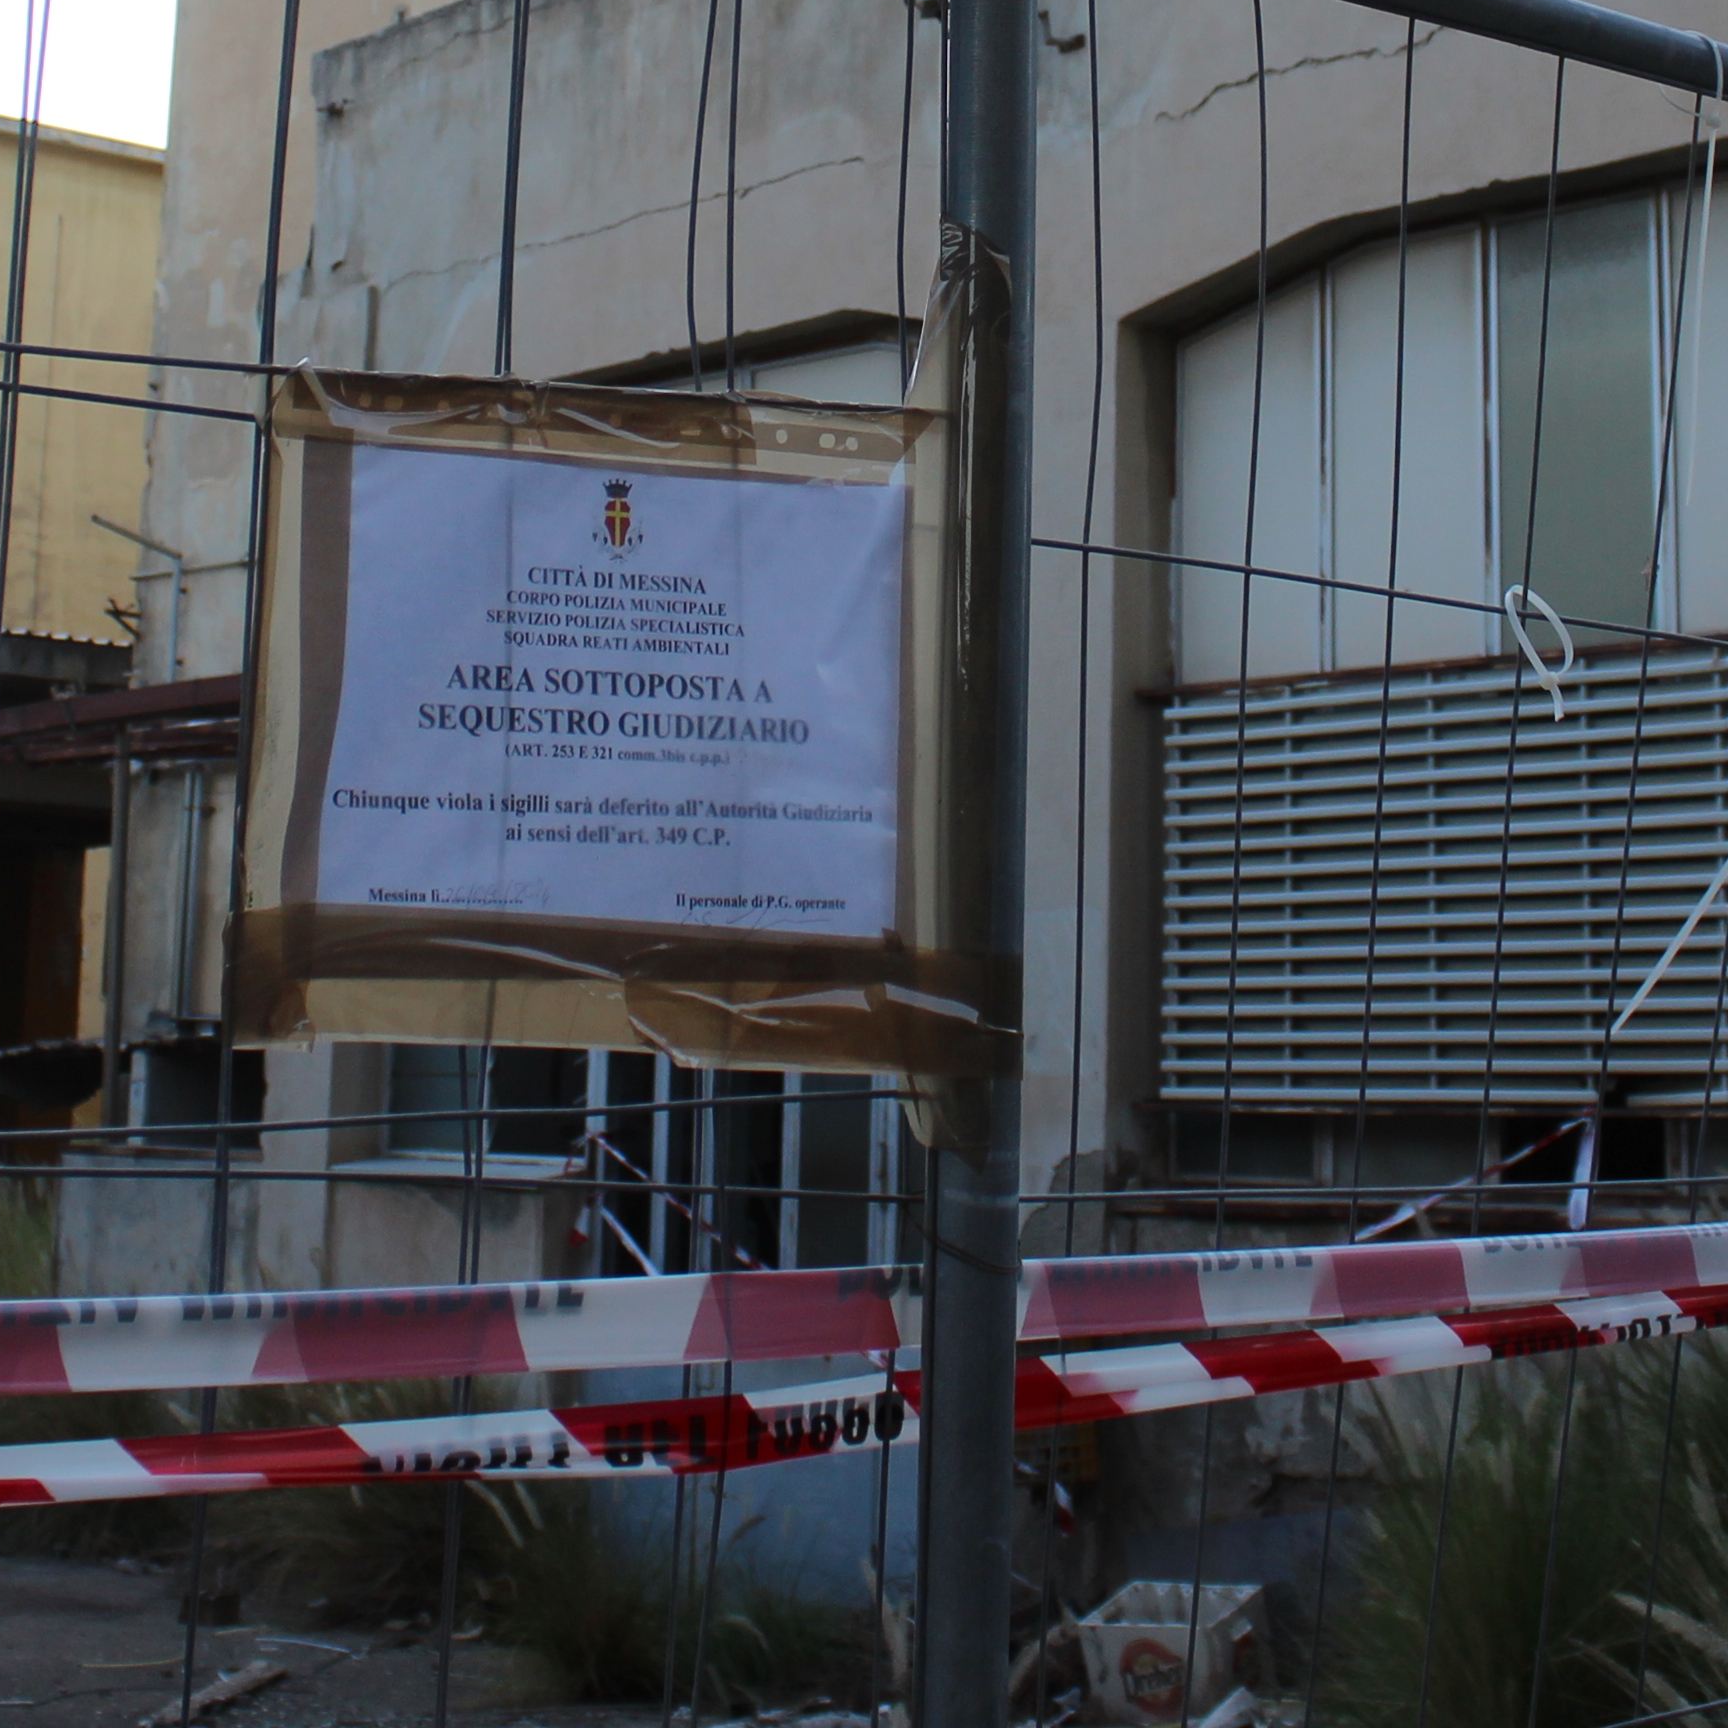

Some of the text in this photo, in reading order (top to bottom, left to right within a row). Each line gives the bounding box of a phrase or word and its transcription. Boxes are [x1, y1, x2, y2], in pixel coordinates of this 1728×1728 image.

[527, 565, 706, 595] CITTÀ DI MESSINA
[506, 590, 727, 617] CORPO POLIZIA MUNICIPALE
[486, 609, 745, 637] SERVIZIO POLIZIA SPECIALISTICA
[503, 630, 730, 656] SQUADRA REATI AMBIENTALI
[446, 664, 774, 703] AREA SOTTOPOSTA A
[417, 703, 811, 745] SEQUESTRO GIUDIZIARIO
[505, 743, 547, 758] (ART.
[552, 745, 574, 759] 253
[579, 746, 588, 759] E
[591, 746, 613, 760] 321
[332, 788, 430, 815] Chiunque
[436, 792, 483, 811] viola
[489, 793, 495, 812] i
[500, 794, 550, 817] sigilli
[555, 797, 593, 815] sarà
[599, 798, 670, 817] deferito
[782, 802, 872, 822] Giudiziaria
[505, 824, 731, 847] ai sensi dell'art. 349 C.P.
[368, 887, 426, 904] Messina
[676, 893, 846, 912] Il personale di P.G. operante
